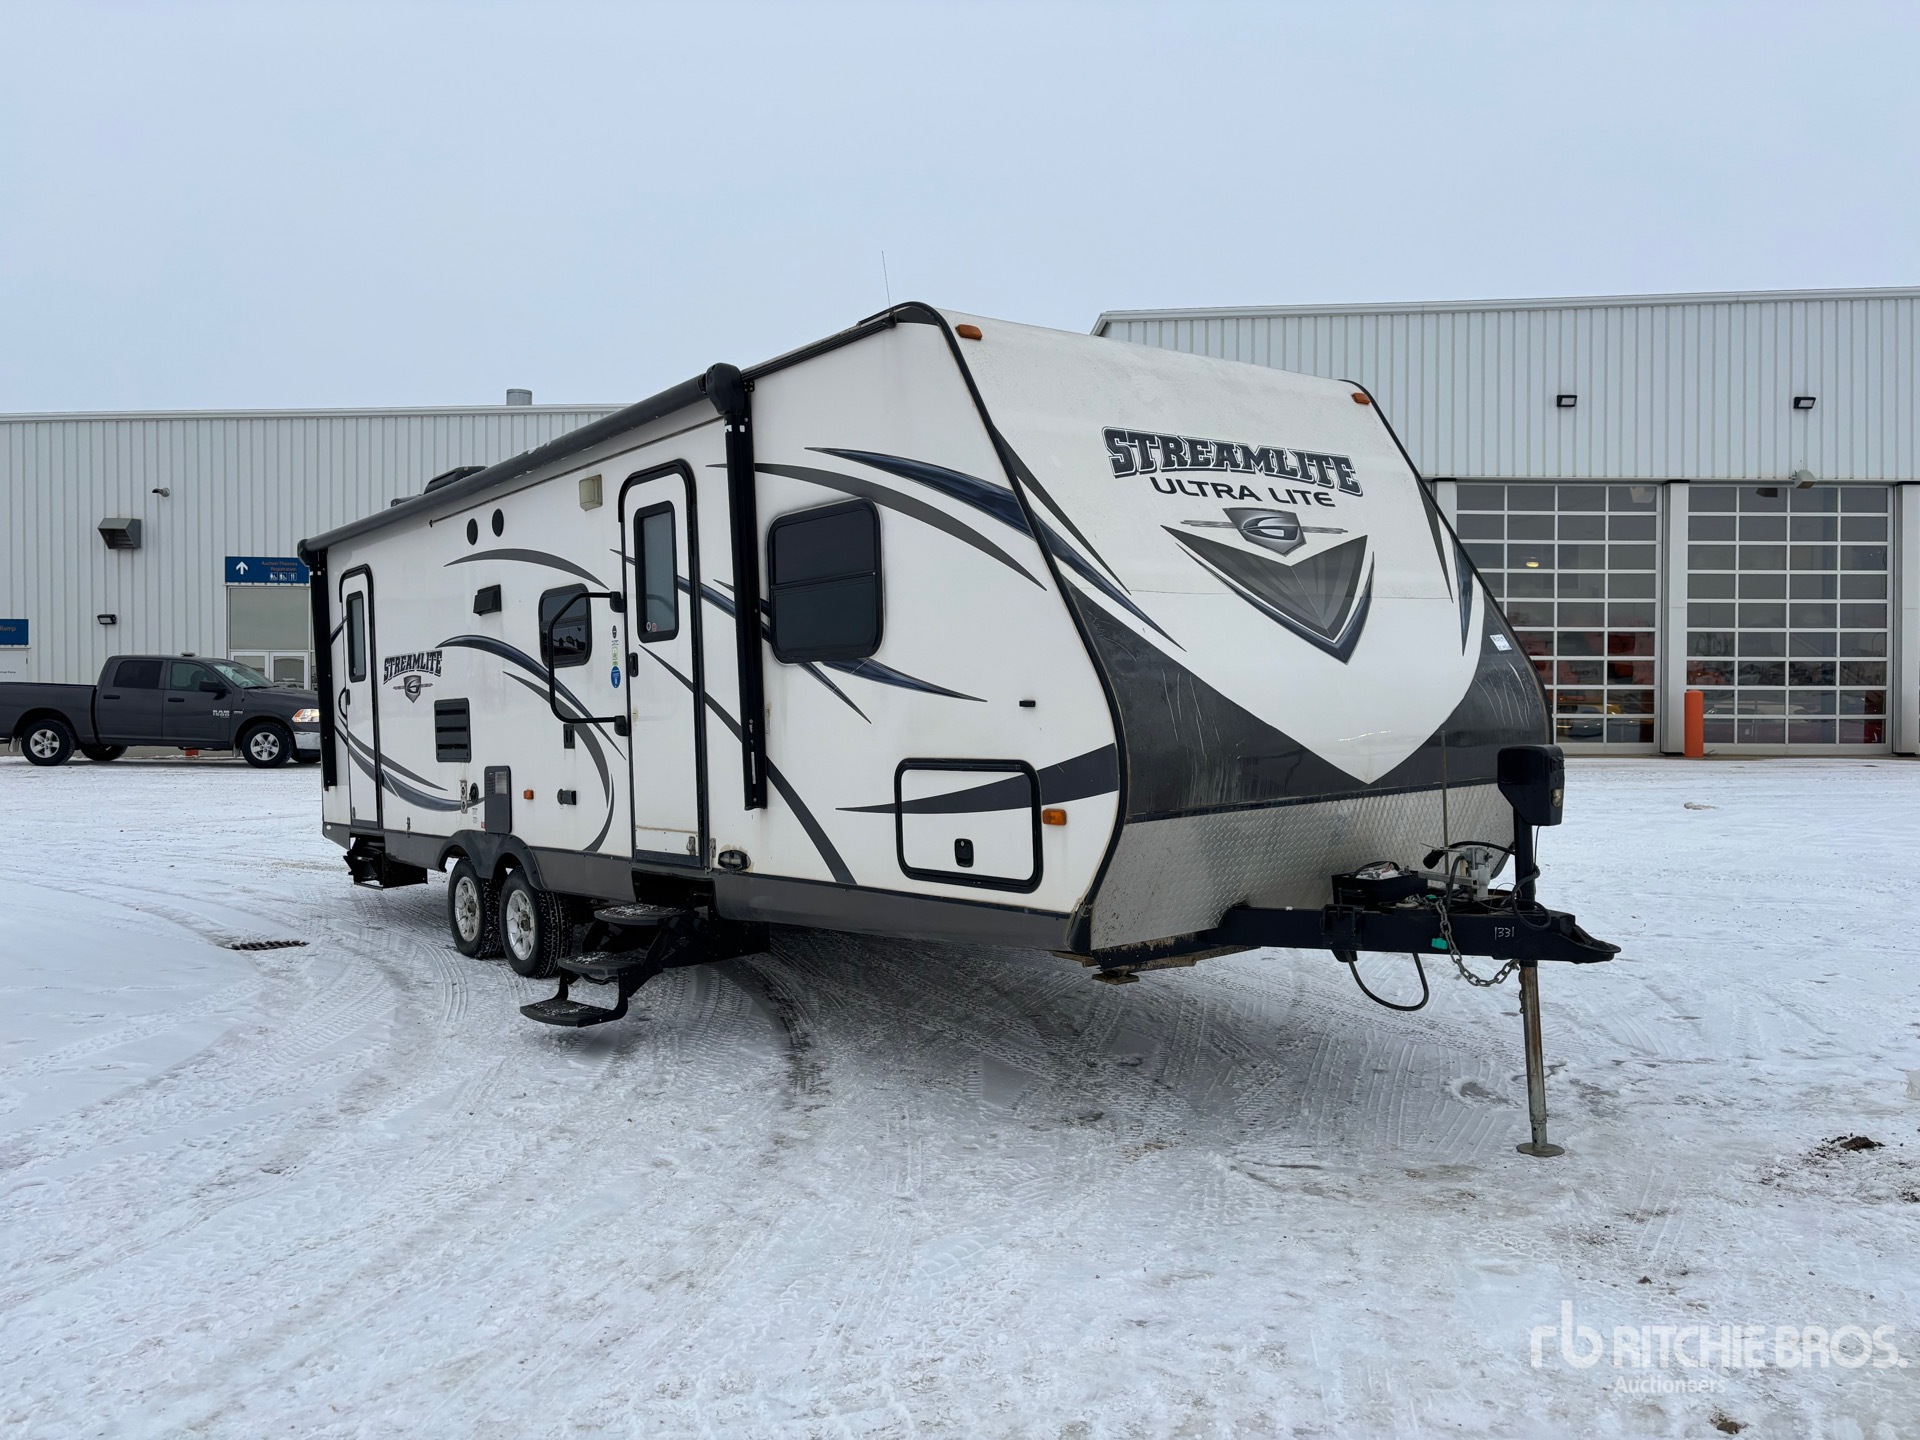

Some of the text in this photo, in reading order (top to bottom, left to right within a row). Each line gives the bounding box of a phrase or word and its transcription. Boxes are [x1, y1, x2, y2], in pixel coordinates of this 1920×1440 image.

[1102, 426, 1363, 496] STREAMLITE
[1150, 476, 1336, 507] ULTRA LITE
[383, 649, 443, 685] STREAMLITE
[1494, 926, 1515, 940] 1331
